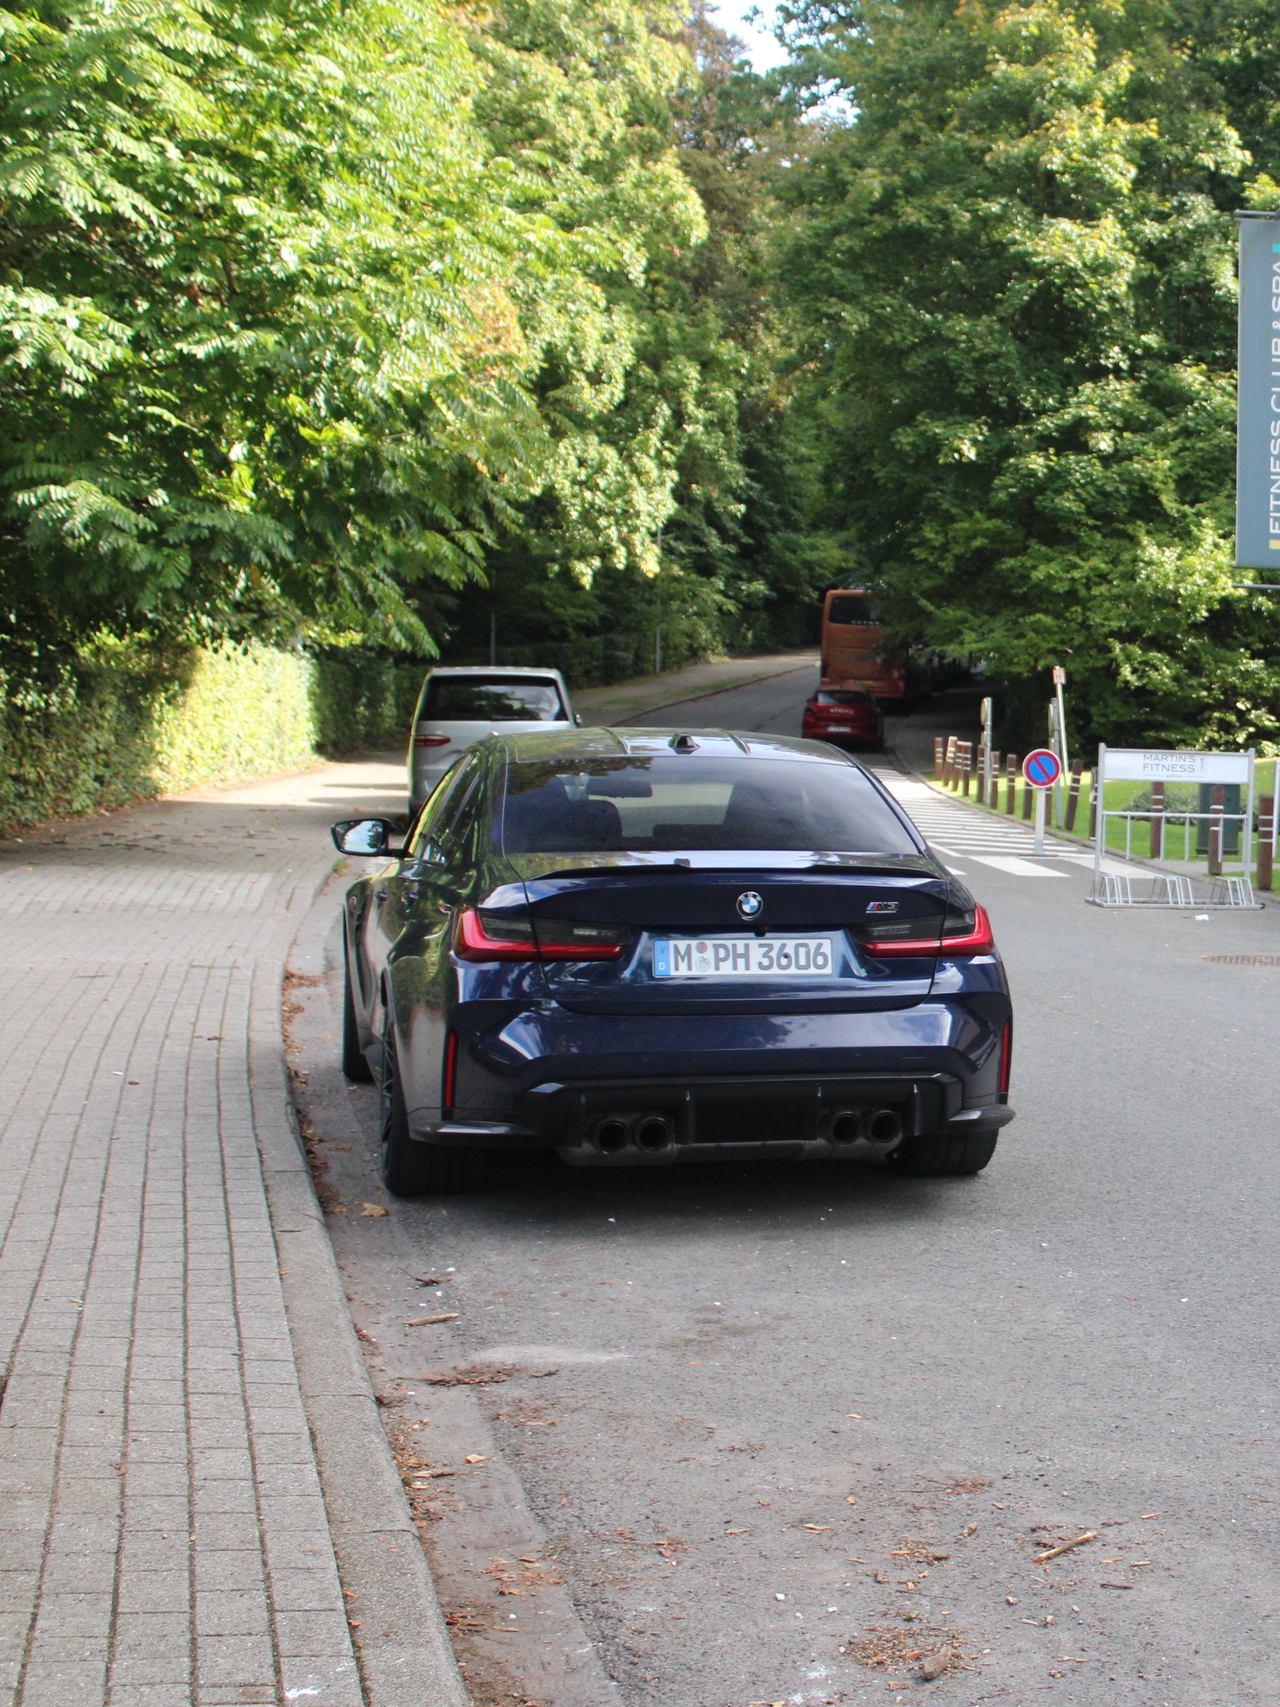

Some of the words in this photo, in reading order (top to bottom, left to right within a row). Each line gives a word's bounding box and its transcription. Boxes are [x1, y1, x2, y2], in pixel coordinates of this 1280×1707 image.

[1143, 753, 1196, 763] MARTIN'S
[1143, 763, 1196, 773] FITNESS
[673, 943, 693, 972] M
[713, 943, 750, 972] PH
[758, 942, 829, 971] 3606
